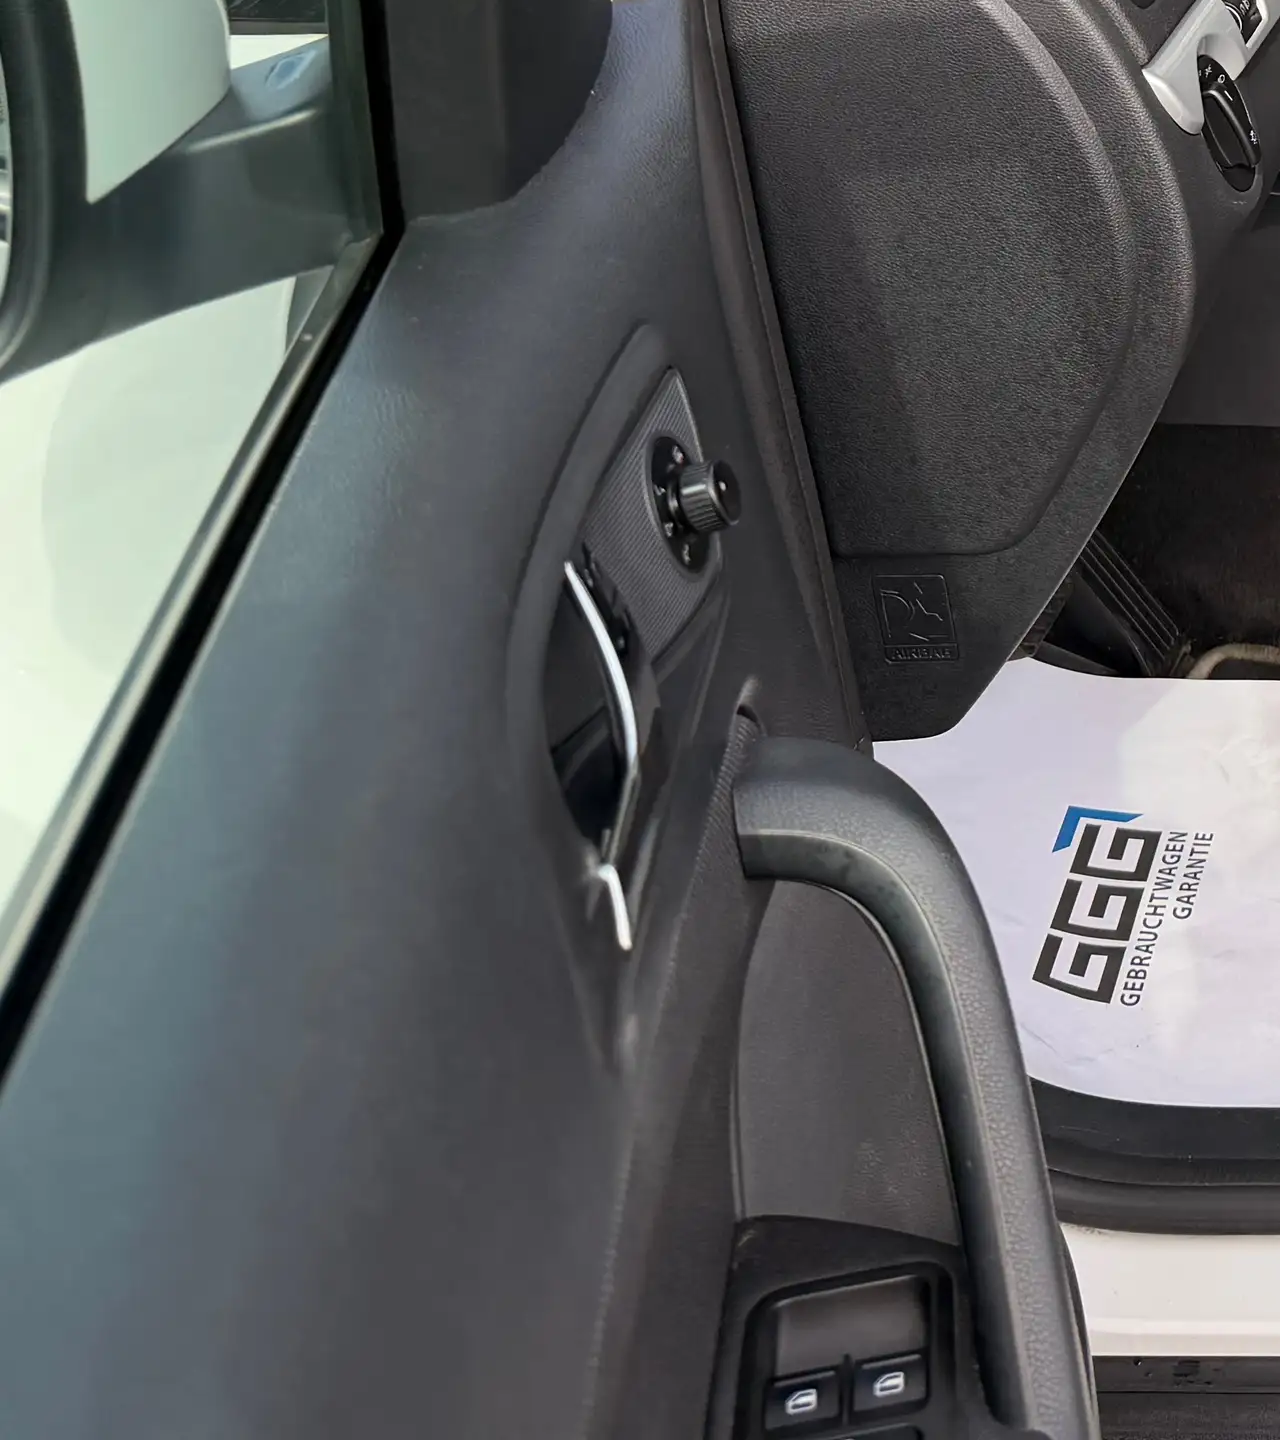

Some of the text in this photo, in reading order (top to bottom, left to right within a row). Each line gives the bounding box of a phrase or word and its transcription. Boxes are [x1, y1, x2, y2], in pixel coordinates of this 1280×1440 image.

[1032, 823, 1162, 1004] GGG
[1120, 830, 1188, 1007] GEBRAUCHTWAGEN
[1172, 831, 1214, 920] GARANTIE
